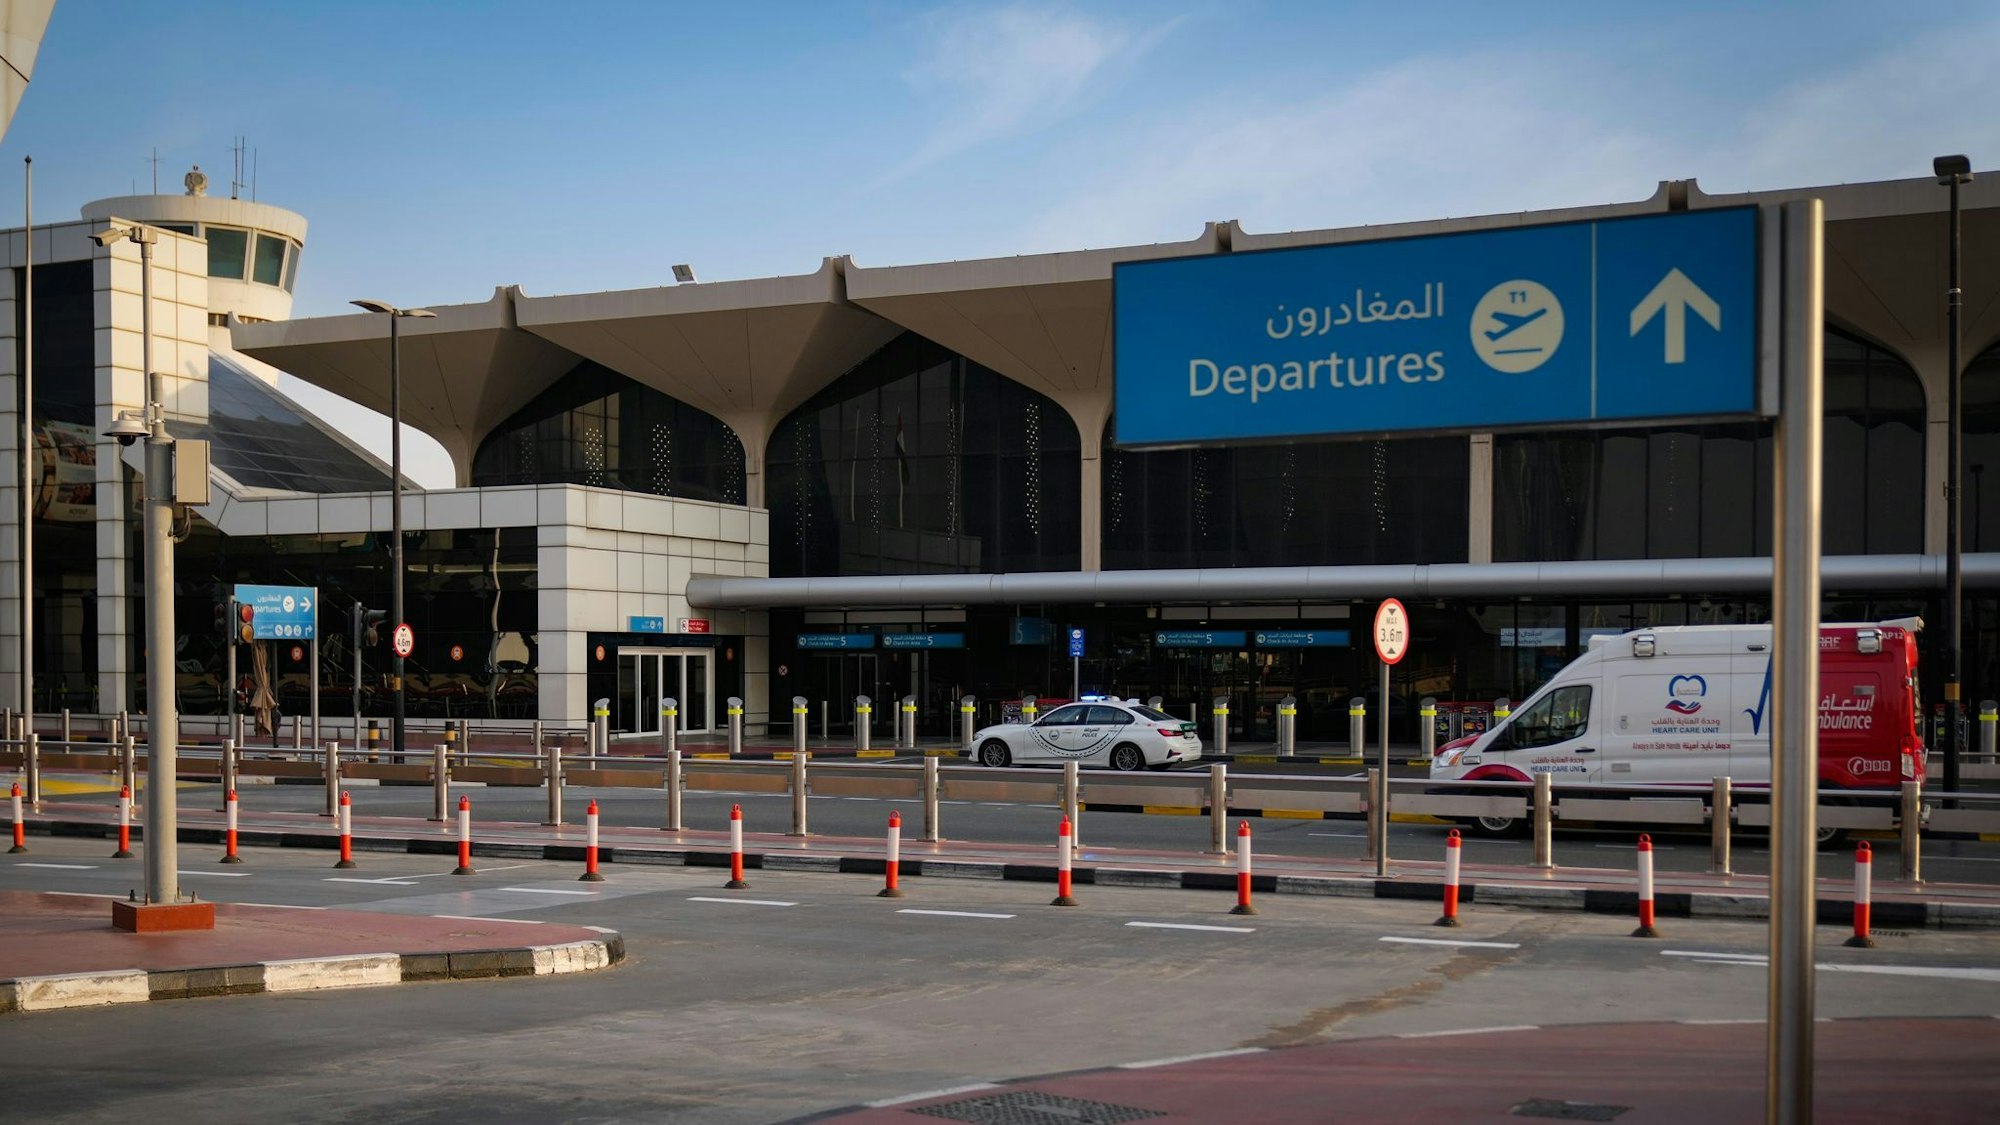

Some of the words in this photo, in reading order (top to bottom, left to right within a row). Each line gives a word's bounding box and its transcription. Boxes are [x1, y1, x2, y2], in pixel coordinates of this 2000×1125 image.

[1509, 290, 1527, 304] T1
[1266, 282, 1445, 338] المغادرون
[1189, 351, 1445, 403] Departures
[840, 636, 846, 646] 5
[927, 636, 933, 645] 5
[1206, 634, 1212, 644] 5
[1307, 633, 1313, 643] 5
[1381, 628, 1403, 642] 3.6m
[1819, 711, 1872, 729] mbulance
